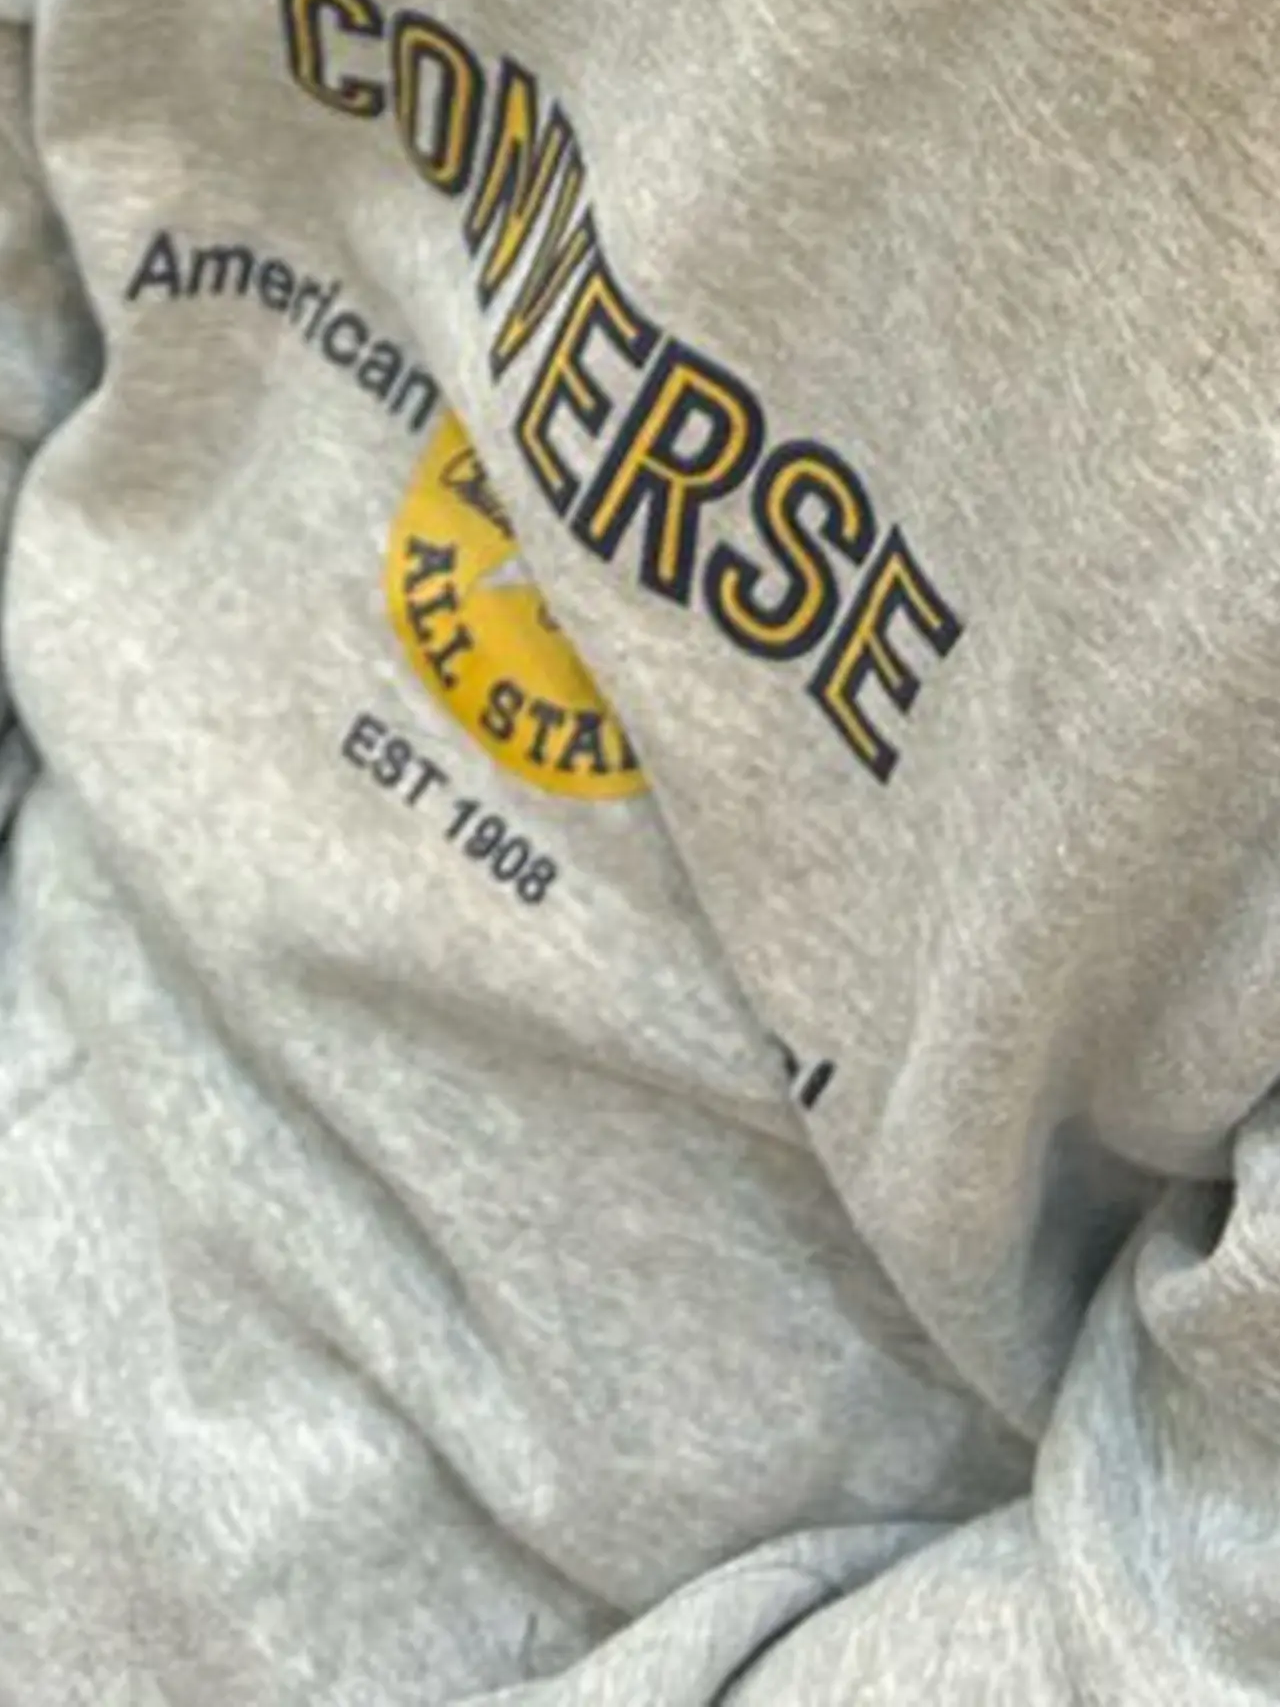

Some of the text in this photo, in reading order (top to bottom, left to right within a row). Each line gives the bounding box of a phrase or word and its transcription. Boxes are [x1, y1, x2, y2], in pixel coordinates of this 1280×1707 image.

[125, 229, 442, 435] American
[404, 533, 640, 775] ALL STA
[342, 713, 558, 905] EST 1908
